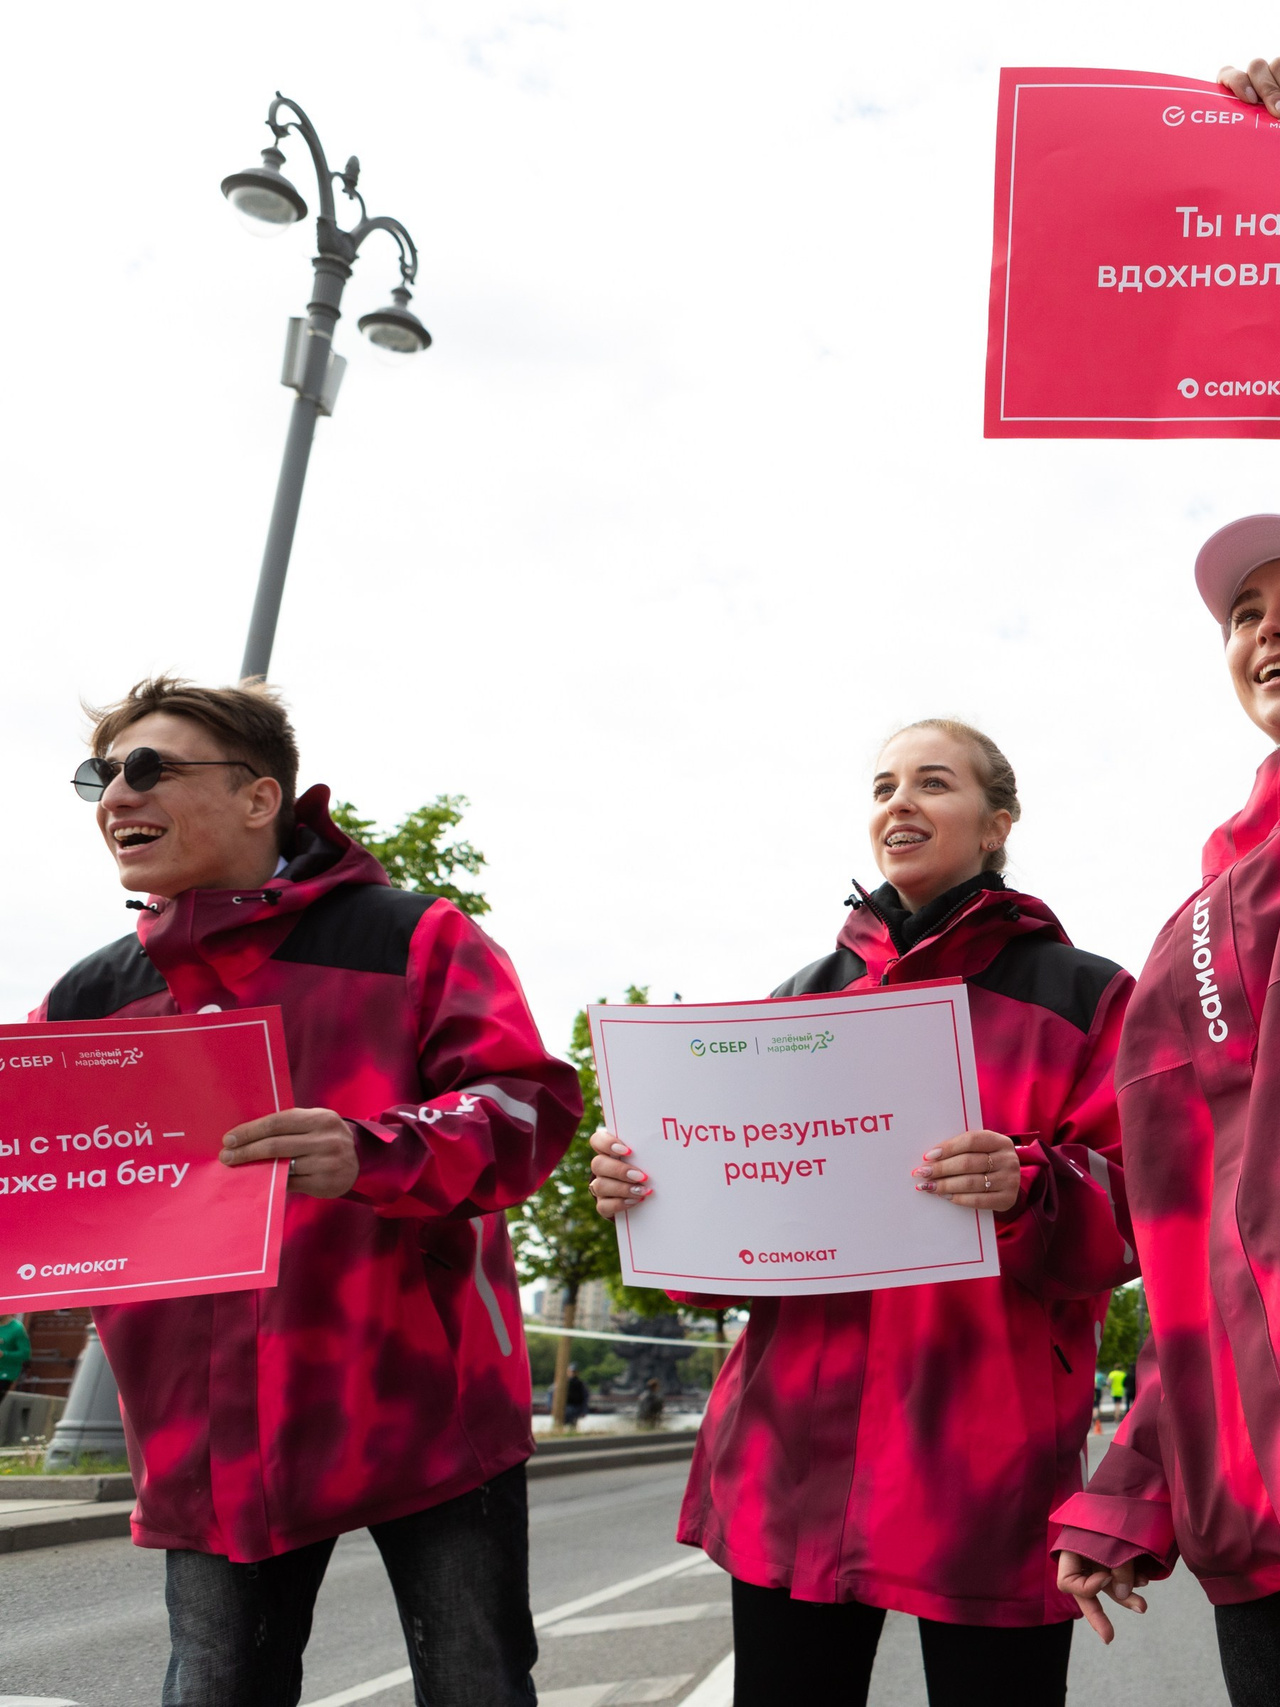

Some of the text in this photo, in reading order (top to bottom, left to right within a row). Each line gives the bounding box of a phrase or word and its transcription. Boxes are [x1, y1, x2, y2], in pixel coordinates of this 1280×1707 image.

[1190, 110, 1245, 124] СБЕР
[1175, 206, 1222, 238] Ты
[1192, 896, 1229, 1043] самокат
[771, 1033, 813, 1044] зелёный
[79, 1048, 122, 1059] зелёный
[709, 1041, 748, 1054] СБЕР
[767, 1042, 810, 1053] марафон
[9, 1055, 54, 1069] СБЕР
[75, 1057, 120, 1068] марафон
[29, 1136, 50, 1154] с
[56, 1121, 153, 1152] тобой
[661, 1112, 894, 1148] Пусть результат
[67, 1169, 107, 1190] на
[116, 1159, 190, 1188] бегу
[724, 1158, 827, 1185] радует
[758, 1247, 838, 1264] самокат
[40, 1257, 129, 1277] самокат
